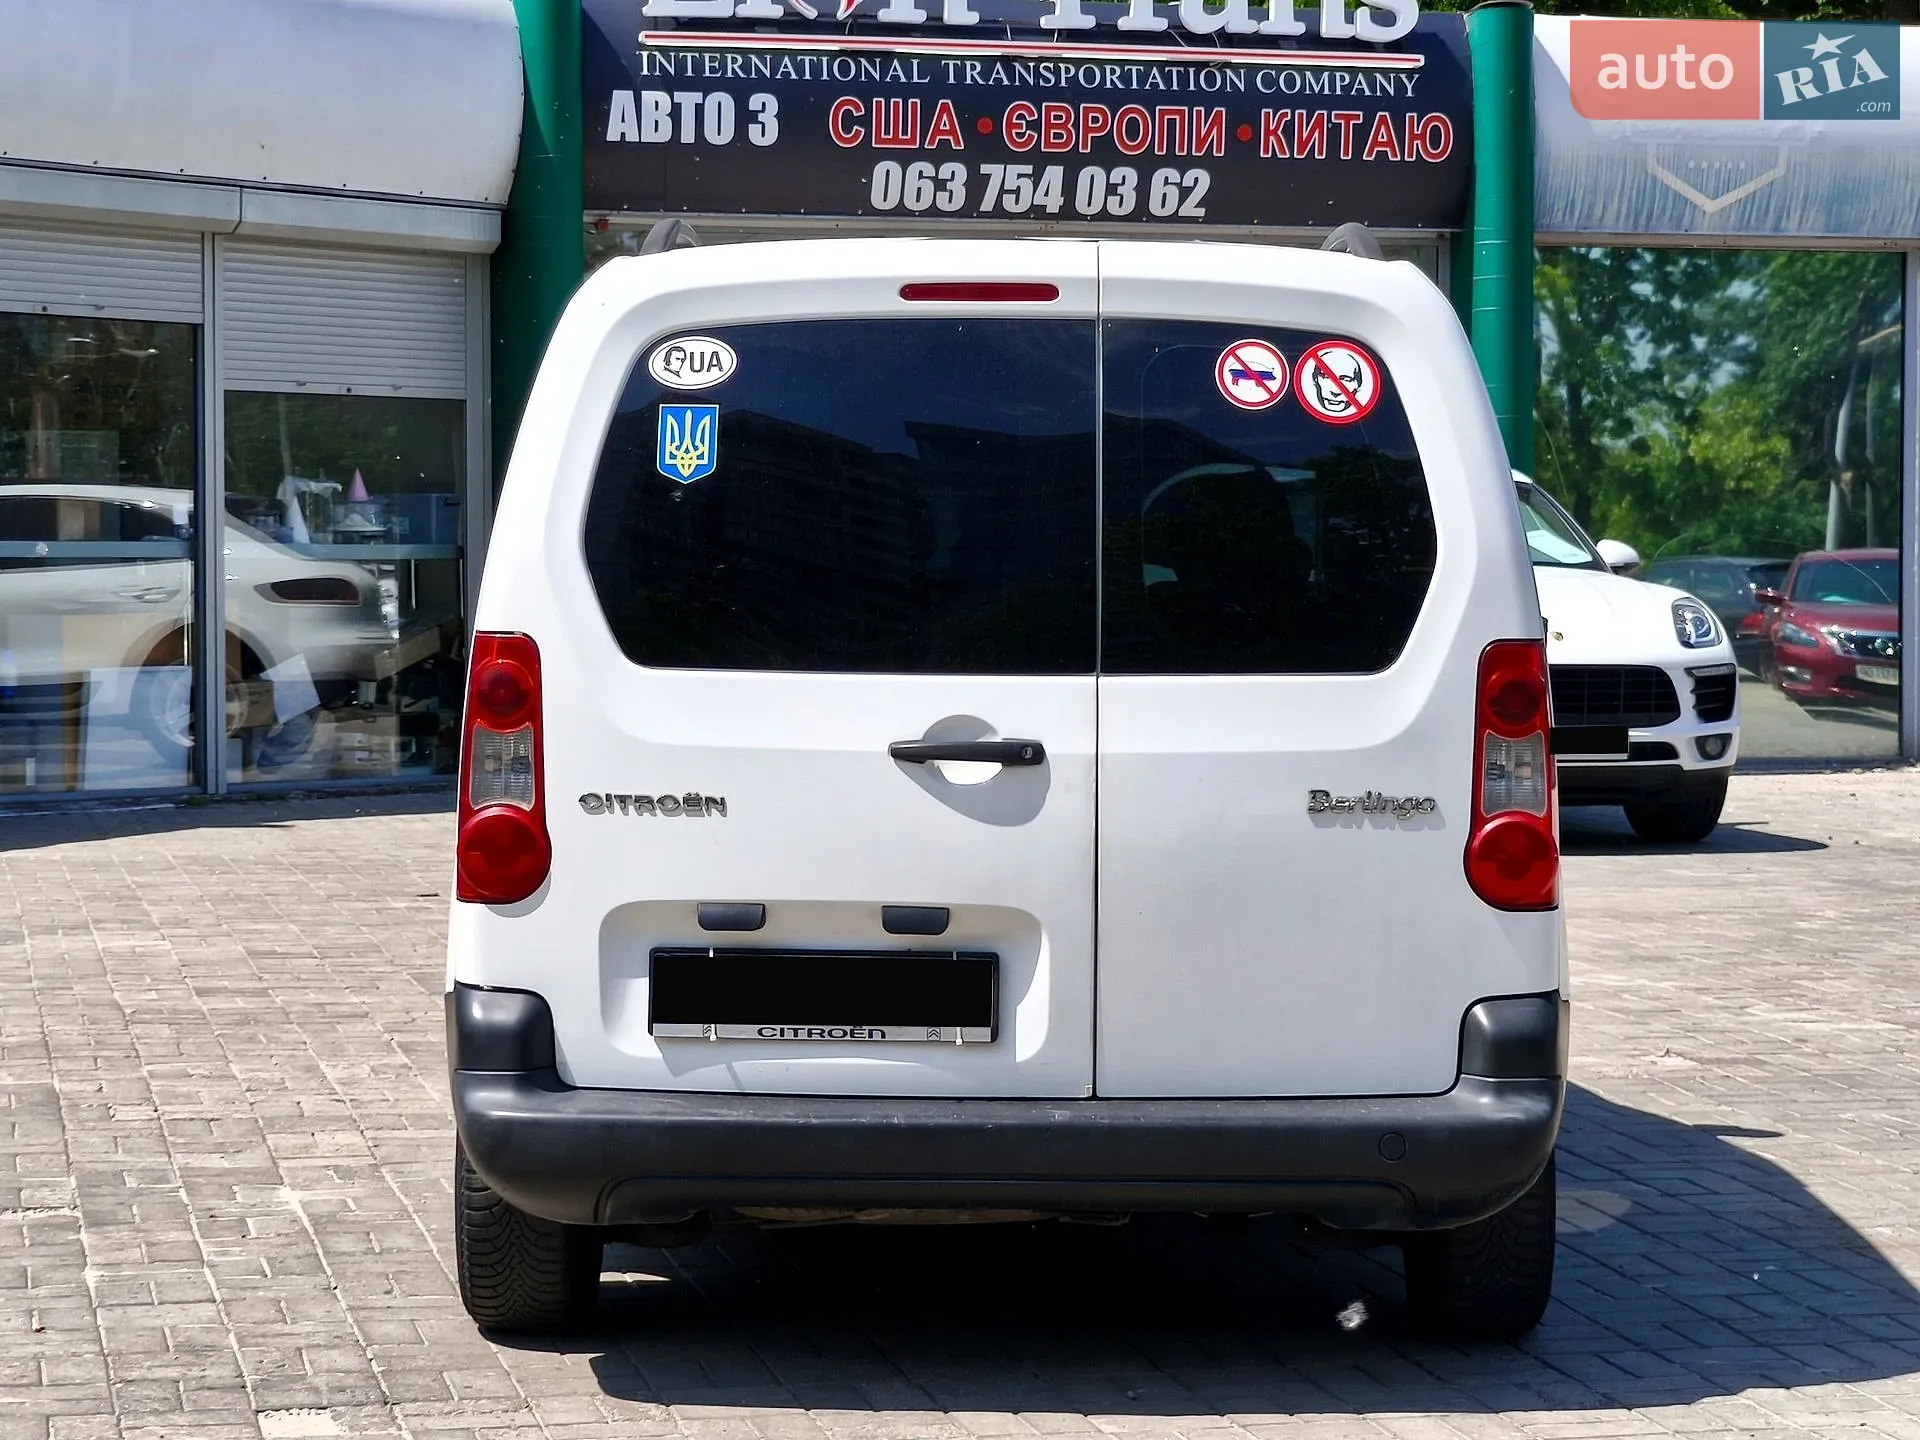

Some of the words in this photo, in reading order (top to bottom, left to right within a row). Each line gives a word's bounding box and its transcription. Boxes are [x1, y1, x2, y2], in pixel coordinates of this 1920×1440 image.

[636, 50, 931, 83] INTERNATIONAL
[941, 60, 1247, 94] TRANSPORTATION
[1256, 68, 1420, 98] COMPANY
[606, 89, 735, 146] АВТО
[829, 96, 965, 150] США
[1002, 100, 1226, 158] ЄВРОПИ
[1259, 108, 1454, 163] КИТАЮ
[870, 160, 967, 213] 063
[979, 164, 1064, 214] 754
[1075, 166, 1138, 217] 03
[1148, 168, 1211, 218] 62
[689, 351, 724, 373] UA
[1307, 789, 1436, 821] Berlingo
